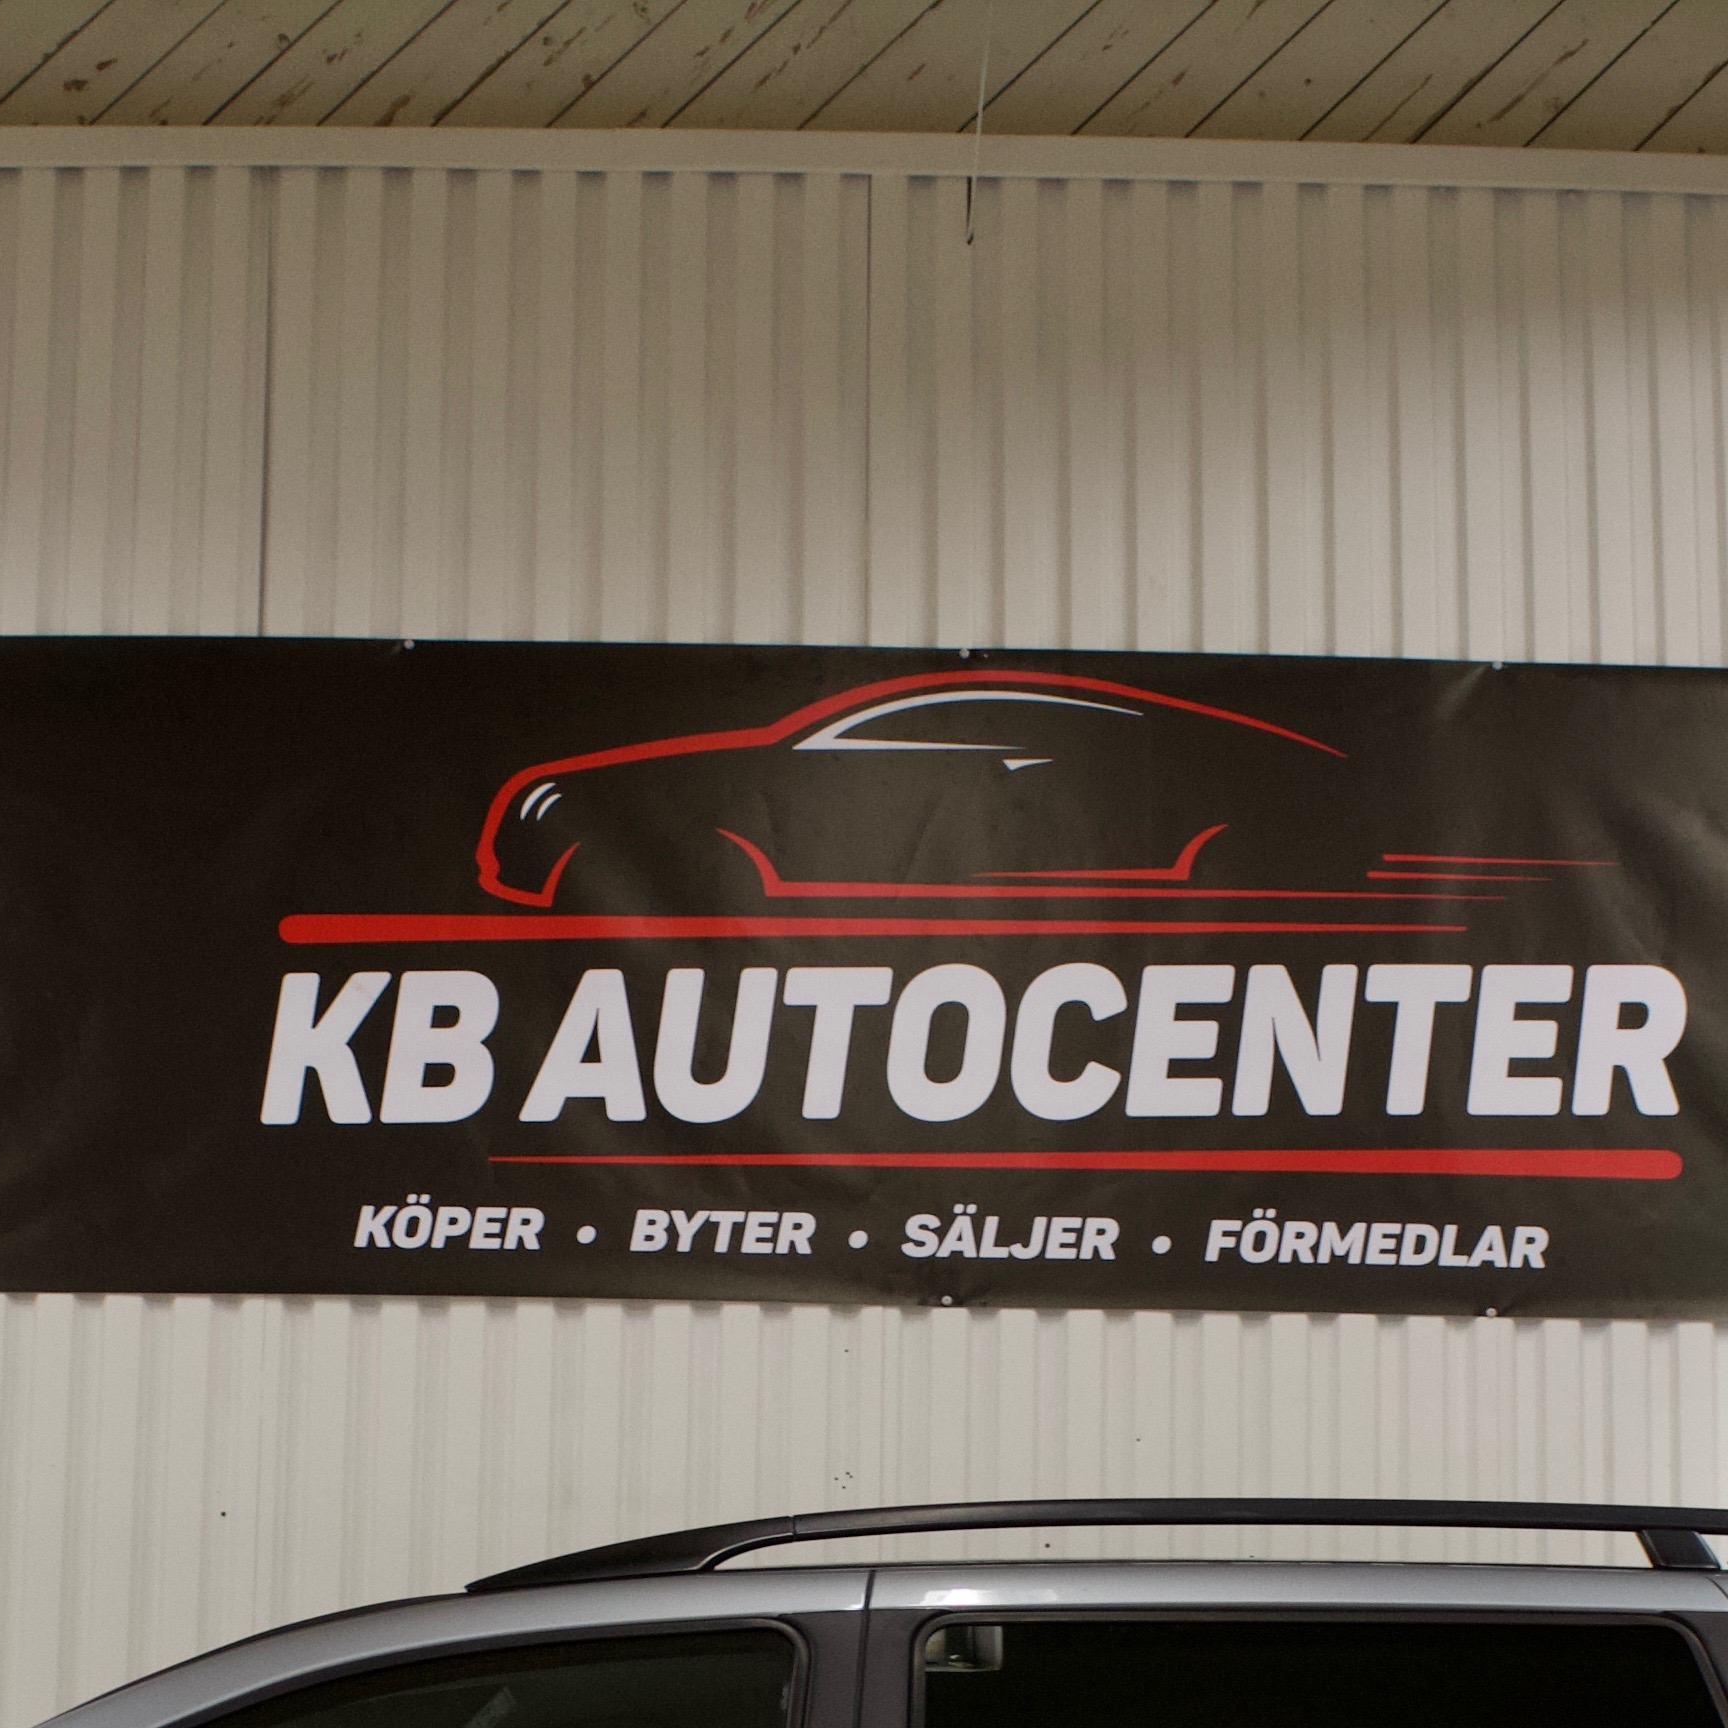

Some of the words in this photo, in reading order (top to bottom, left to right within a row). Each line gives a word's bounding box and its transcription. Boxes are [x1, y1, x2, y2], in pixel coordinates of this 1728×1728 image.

[260, 970, 500, 1125] KB
[519, 962, 1689, 1124] AUTOCENTER
[353, 1193, 545, 1250] KÖPER
[629, 1209, 817, 1255] BYTER
[900, 1203, 1120, 1260] SÄLJER
[1204, 1208, 1549, 1269] FÖRMEDLAR
